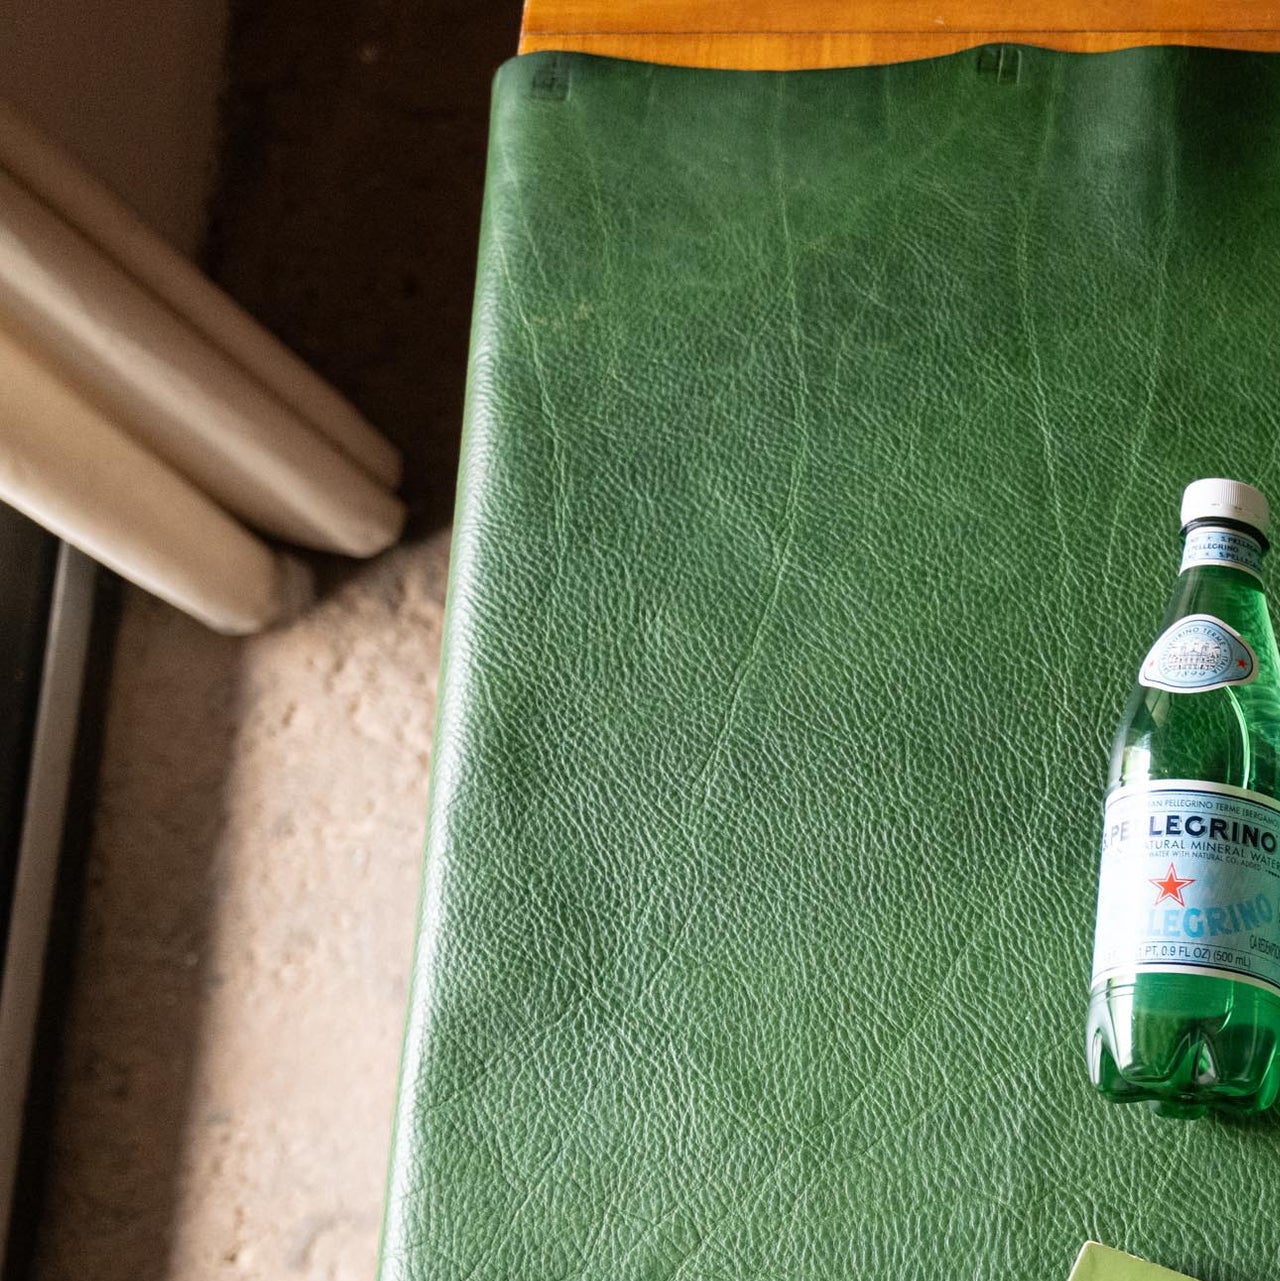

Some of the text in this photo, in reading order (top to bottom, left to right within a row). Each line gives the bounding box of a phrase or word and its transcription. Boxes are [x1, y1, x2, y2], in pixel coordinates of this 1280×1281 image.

[1164, 799, 1214, 810] PELLEGRINO
[1215, 803, 1241, 814] TERME
[1191, 841, 1245, 858] MINERAL
[1192, 852, 1223, 862] NATURAL
[1161, 945, 1175, 957] 0.9
[1179, 946, 1190, 957] FL
[1194, 947, 1211, 961] OZ)
[1213, 949, 1234, 963] (500
